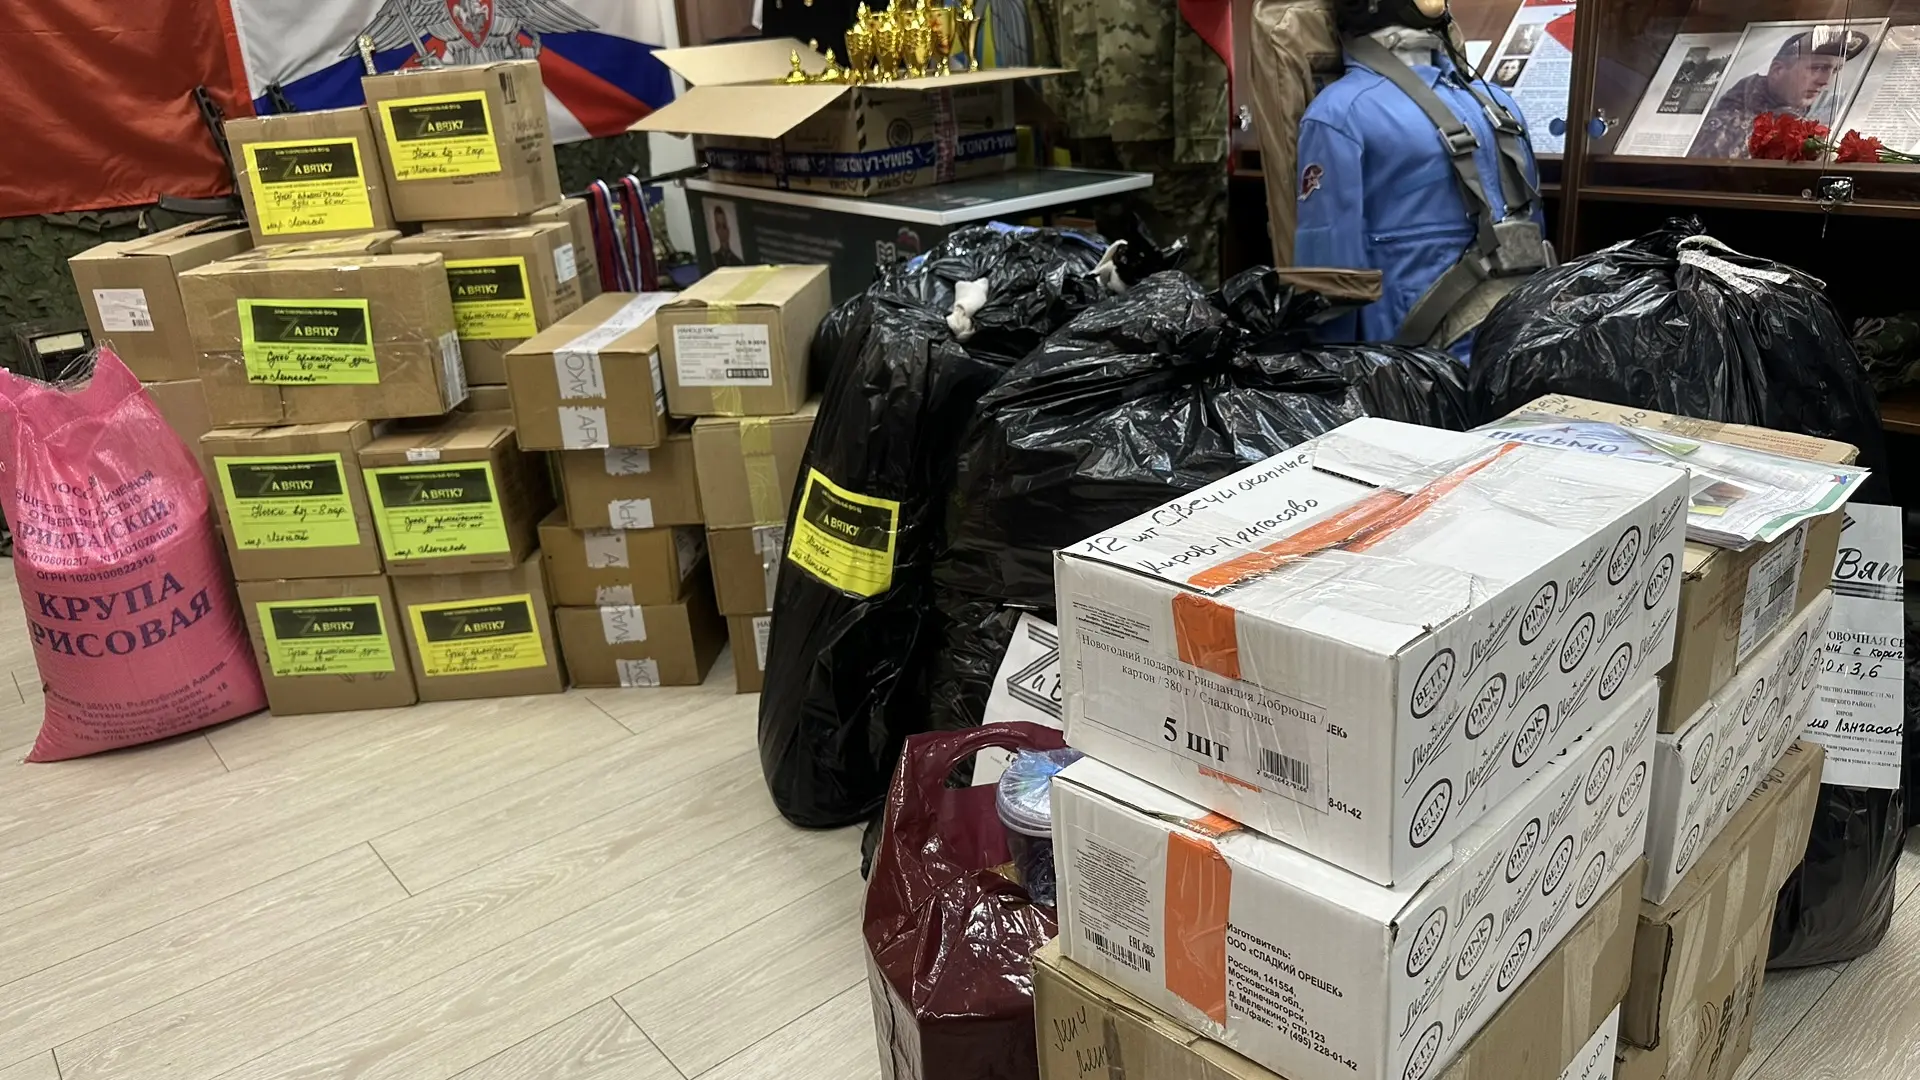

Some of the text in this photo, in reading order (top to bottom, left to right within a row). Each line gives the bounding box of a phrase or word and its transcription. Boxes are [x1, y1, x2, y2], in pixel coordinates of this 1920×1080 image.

[1087, 536, 1128, 556] 12
[1238, 452, 1310, 492] окопные
[36, 570, 68, 583] ОГРН
[1611, 533, 1637, 575] BETTY
[35, 571, 186, 622] КРУПА
[1648, 558, 1670, 598] PINK
[31, 587, 213, 659] РИСОВАЯ
[1524, 584, 1552, 631] PINK
[1562, 618, 1591, 664] BETTY
[1827, 629, 1887, 647] ОВОЧНАЯ
[1082, 634, 1141, 664] Новогодний
[1142, 655, 1185, 678] подарок
[1187, 668, 1255, 702] Гринландия
[1257, 693, 1317, 725] Добрюша
[1415, 655, 1449, 707] BETTY
[1602, 650, 1628, 692] BETTY
[1849, 661, 1883, 680] 3,6
[1121, 664, 1156, 685] картон
[1164, 677, 1182, 692] 380
[1199, 691, 1275, 726] Сладкополис
[1470, 678, 1501, 725] PINK
[1163, 715, 1230, 763] 5 шт
[1516, 709, 1544, 753] PINK
[1413, 784, 1446, 837] BETTY
[1510, 822, 1536, 869] PINK
[1226, 921, 1292, 960] Изготовитель:
[1411, 912, 1442, 968] BETTY
[1461, 920, 1488, 967] PINK
[1501, 935, 1527, 978] PINK
[1226, 936, 1344, 998] ООО «СЛАДКИЙ ОРЕШЕК»
[1227, 955, 1297, 998] Россия, 141554,
[1228, 966, 1305, 1013] Московская обл.,
[1236, 981, 1309, 1026] Солнечногорск,
[1238, 993, 1290, 1027] Мелечкино,
[1291, 1022, 1326, 1045] стр.123
[1229, 998, 1359, 1072] Тел./факс: +7 (495) 228-01-42
